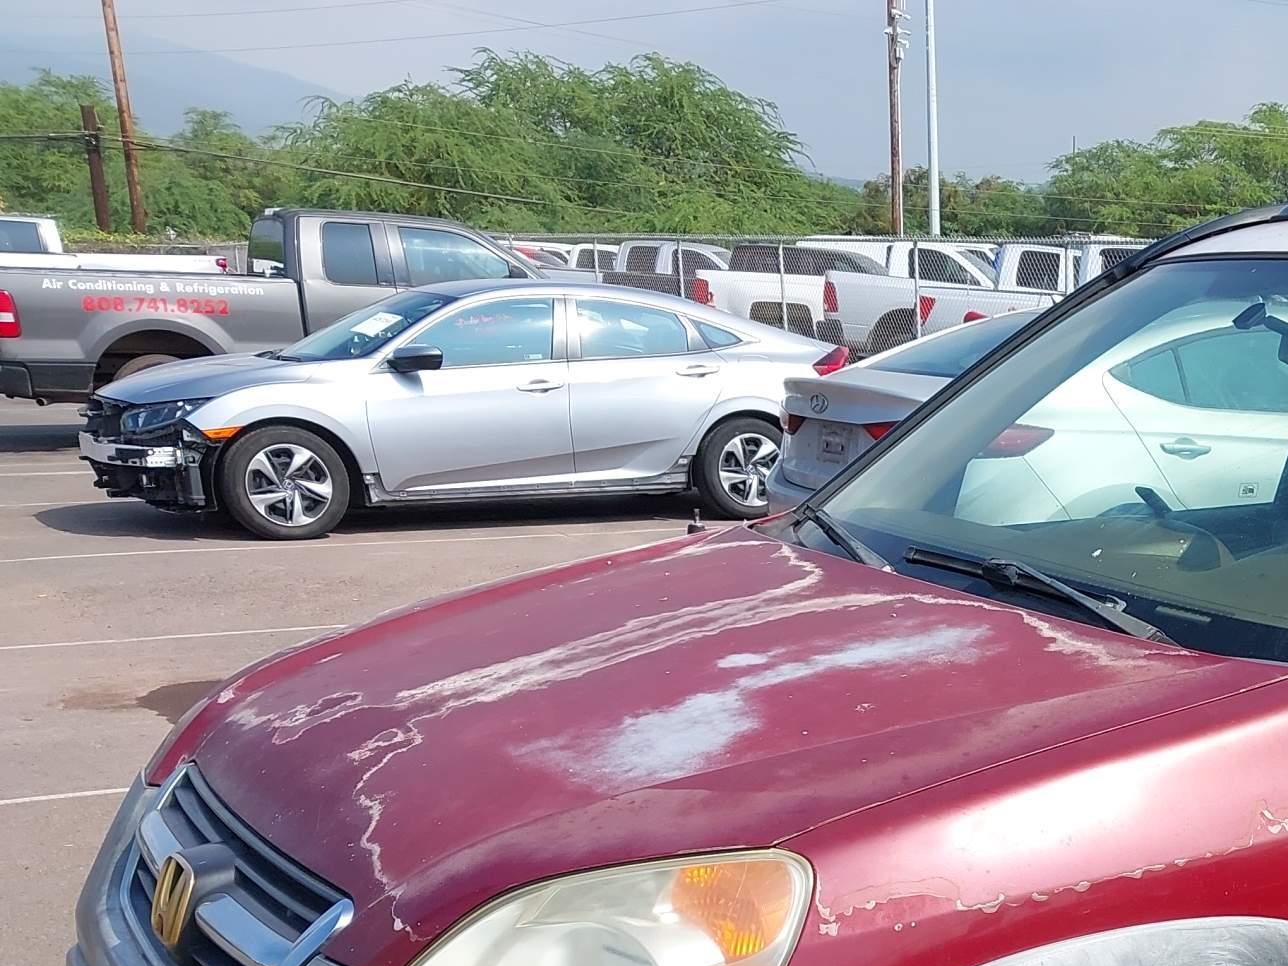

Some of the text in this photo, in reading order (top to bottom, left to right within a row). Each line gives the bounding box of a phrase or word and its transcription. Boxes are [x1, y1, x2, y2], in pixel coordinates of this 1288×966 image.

[42, 278, 264, 296] Air Conditioning & Refrigeration
